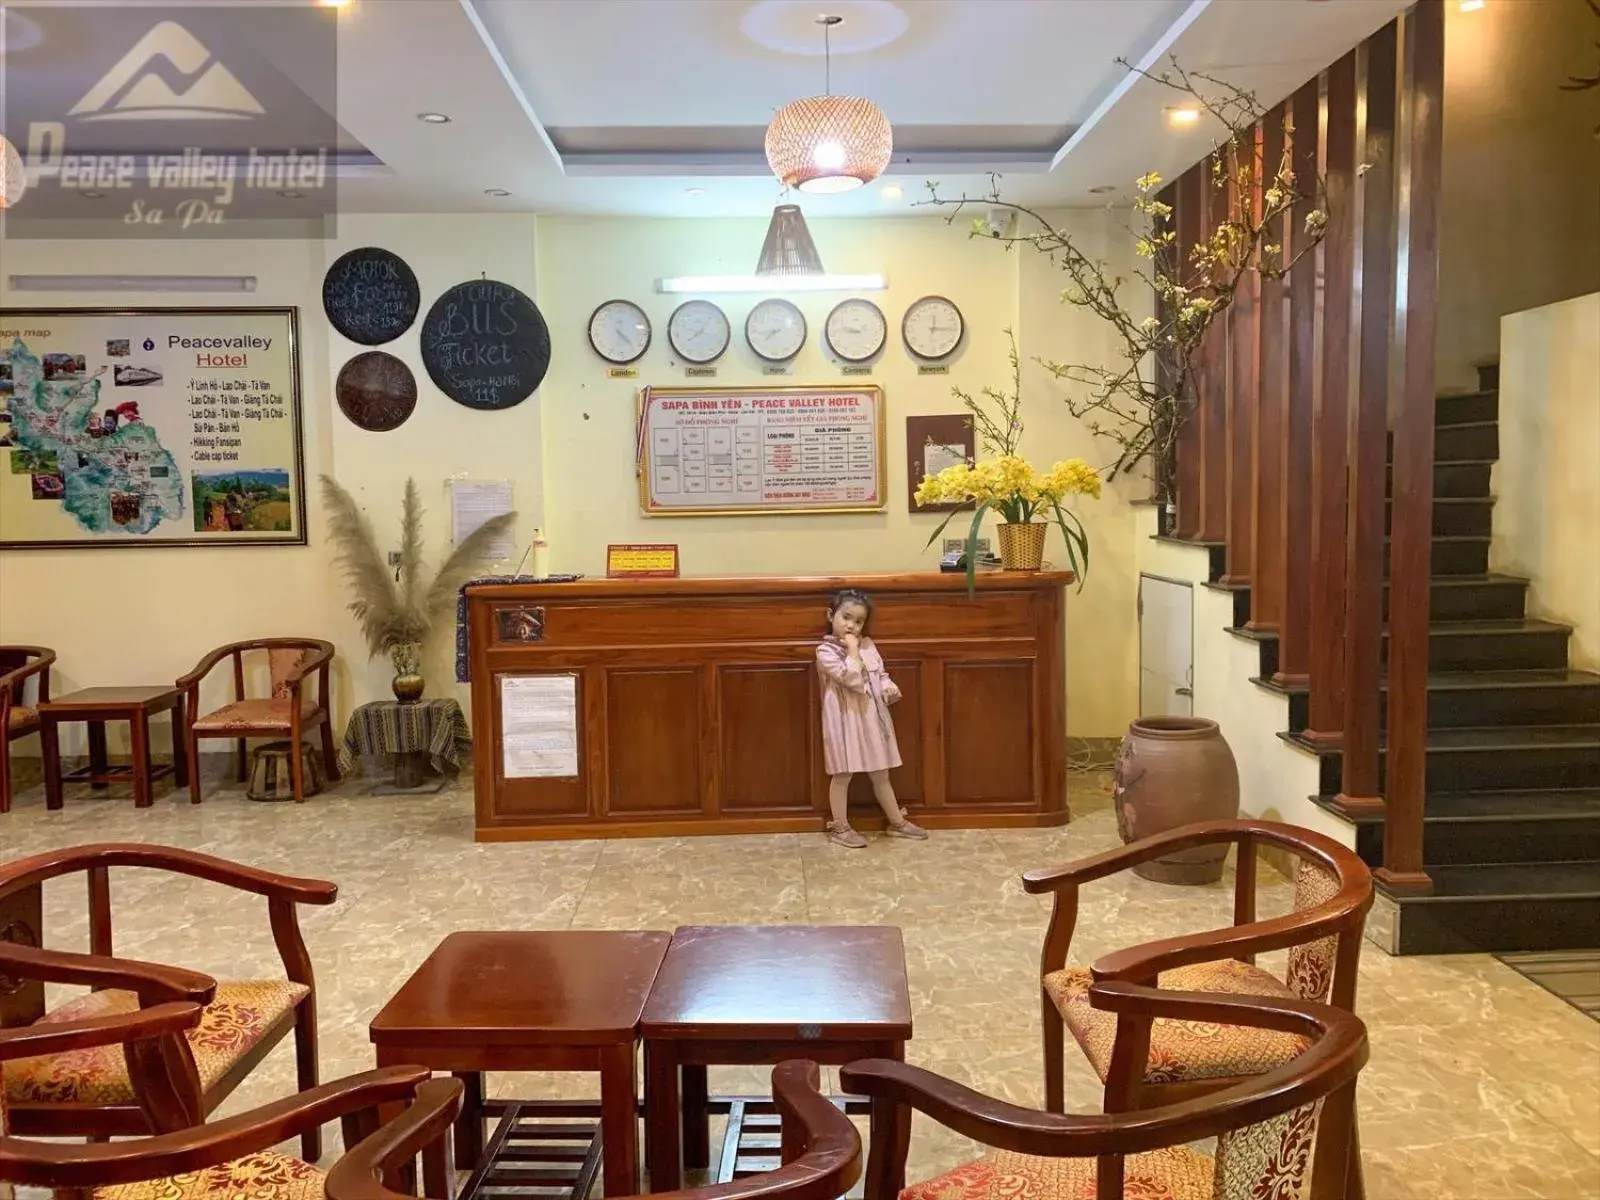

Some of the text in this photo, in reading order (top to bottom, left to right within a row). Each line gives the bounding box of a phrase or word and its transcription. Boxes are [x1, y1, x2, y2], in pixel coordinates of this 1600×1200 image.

[438, 302, 518, 336] BUS
[24, 329, 52, 338] map
[168, 335, 272, 351] Peacevalley
[196, 353, 248, 366] Hotel
[661, 400, 689, 410] SAPA
[692, 399, 718, 410] BÌNH
[721, 399, 742, 409] YÊN
[751, 399, 786, 408] PEACE
[788, 398, 826, 407] VALLEY
[828, 397, 861, 406] HOTEL
